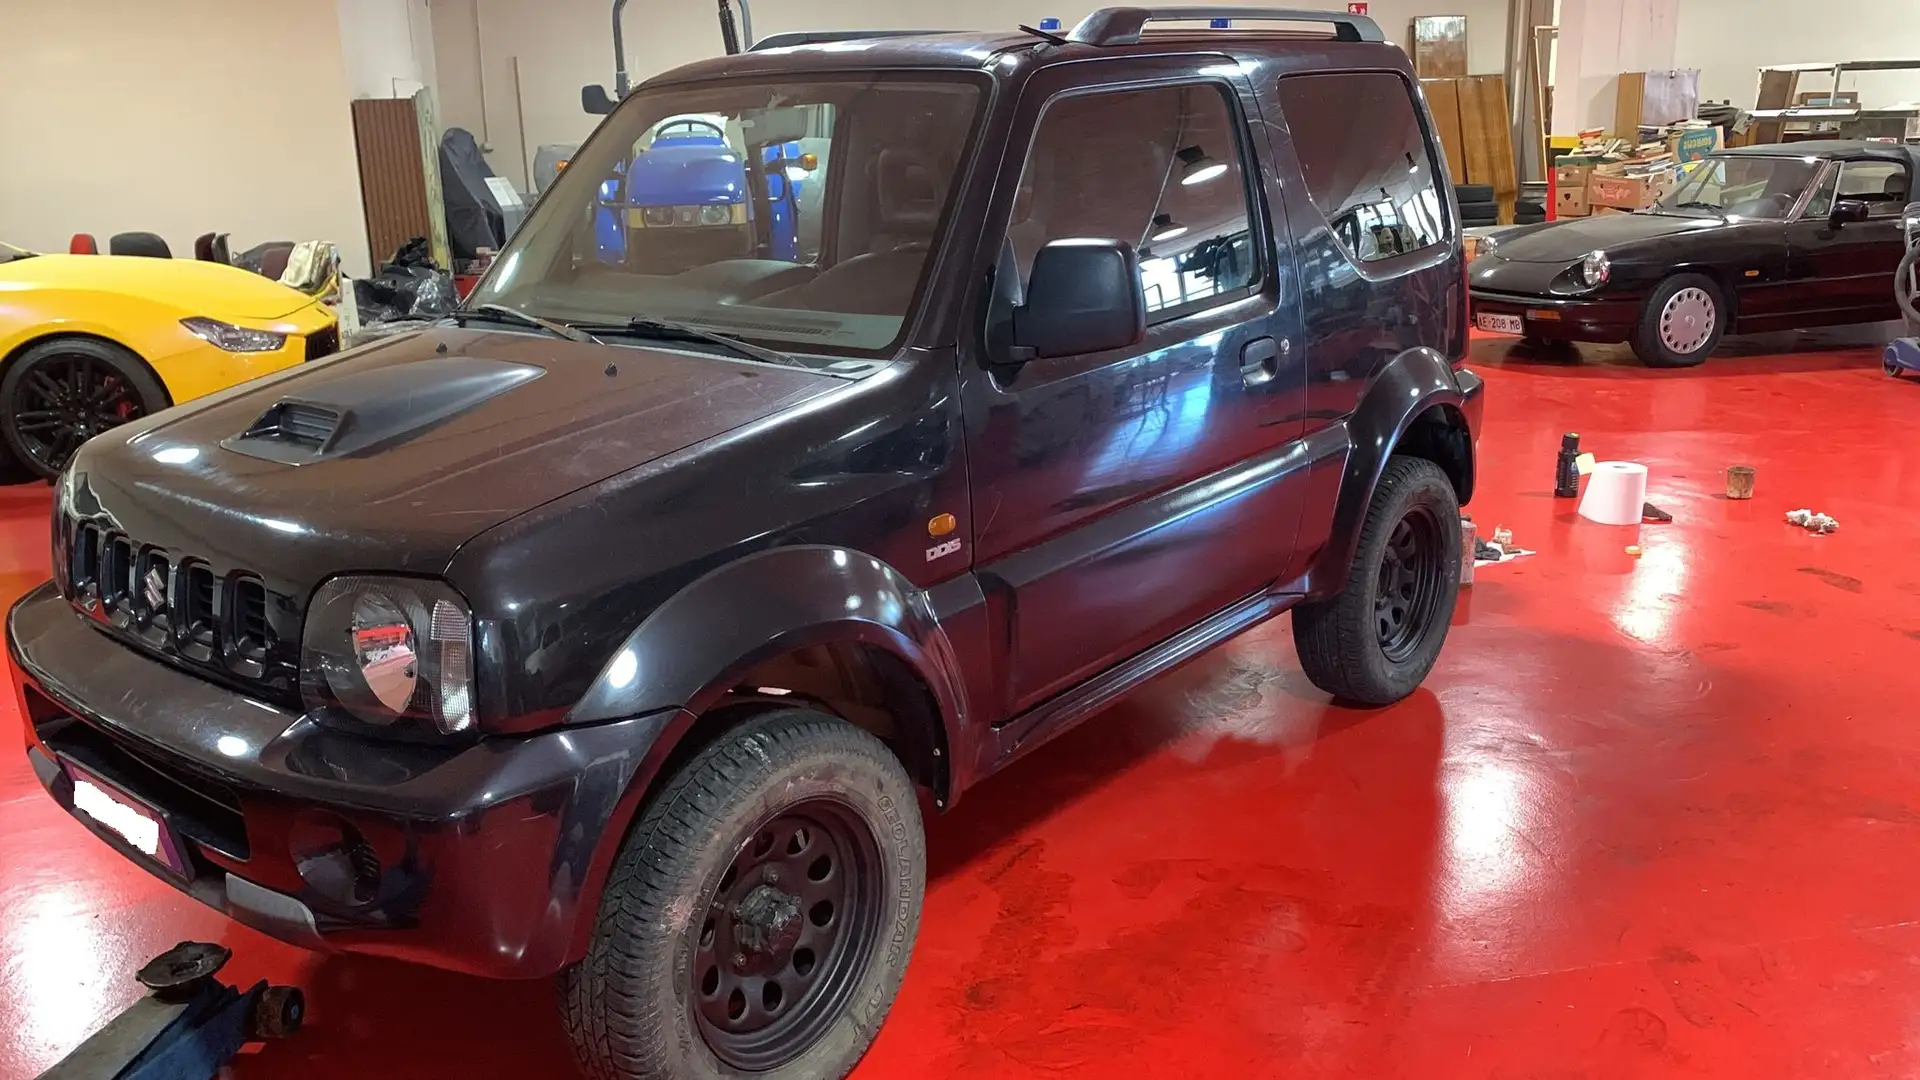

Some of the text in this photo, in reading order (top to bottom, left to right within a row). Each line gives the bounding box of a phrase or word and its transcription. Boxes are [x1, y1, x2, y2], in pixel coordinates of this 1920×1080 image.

[1491, 317, 1506, 329] 208
[1509, 319, 1521, 330] MB
[877, 795, 912, 968] GEOLANDAR
